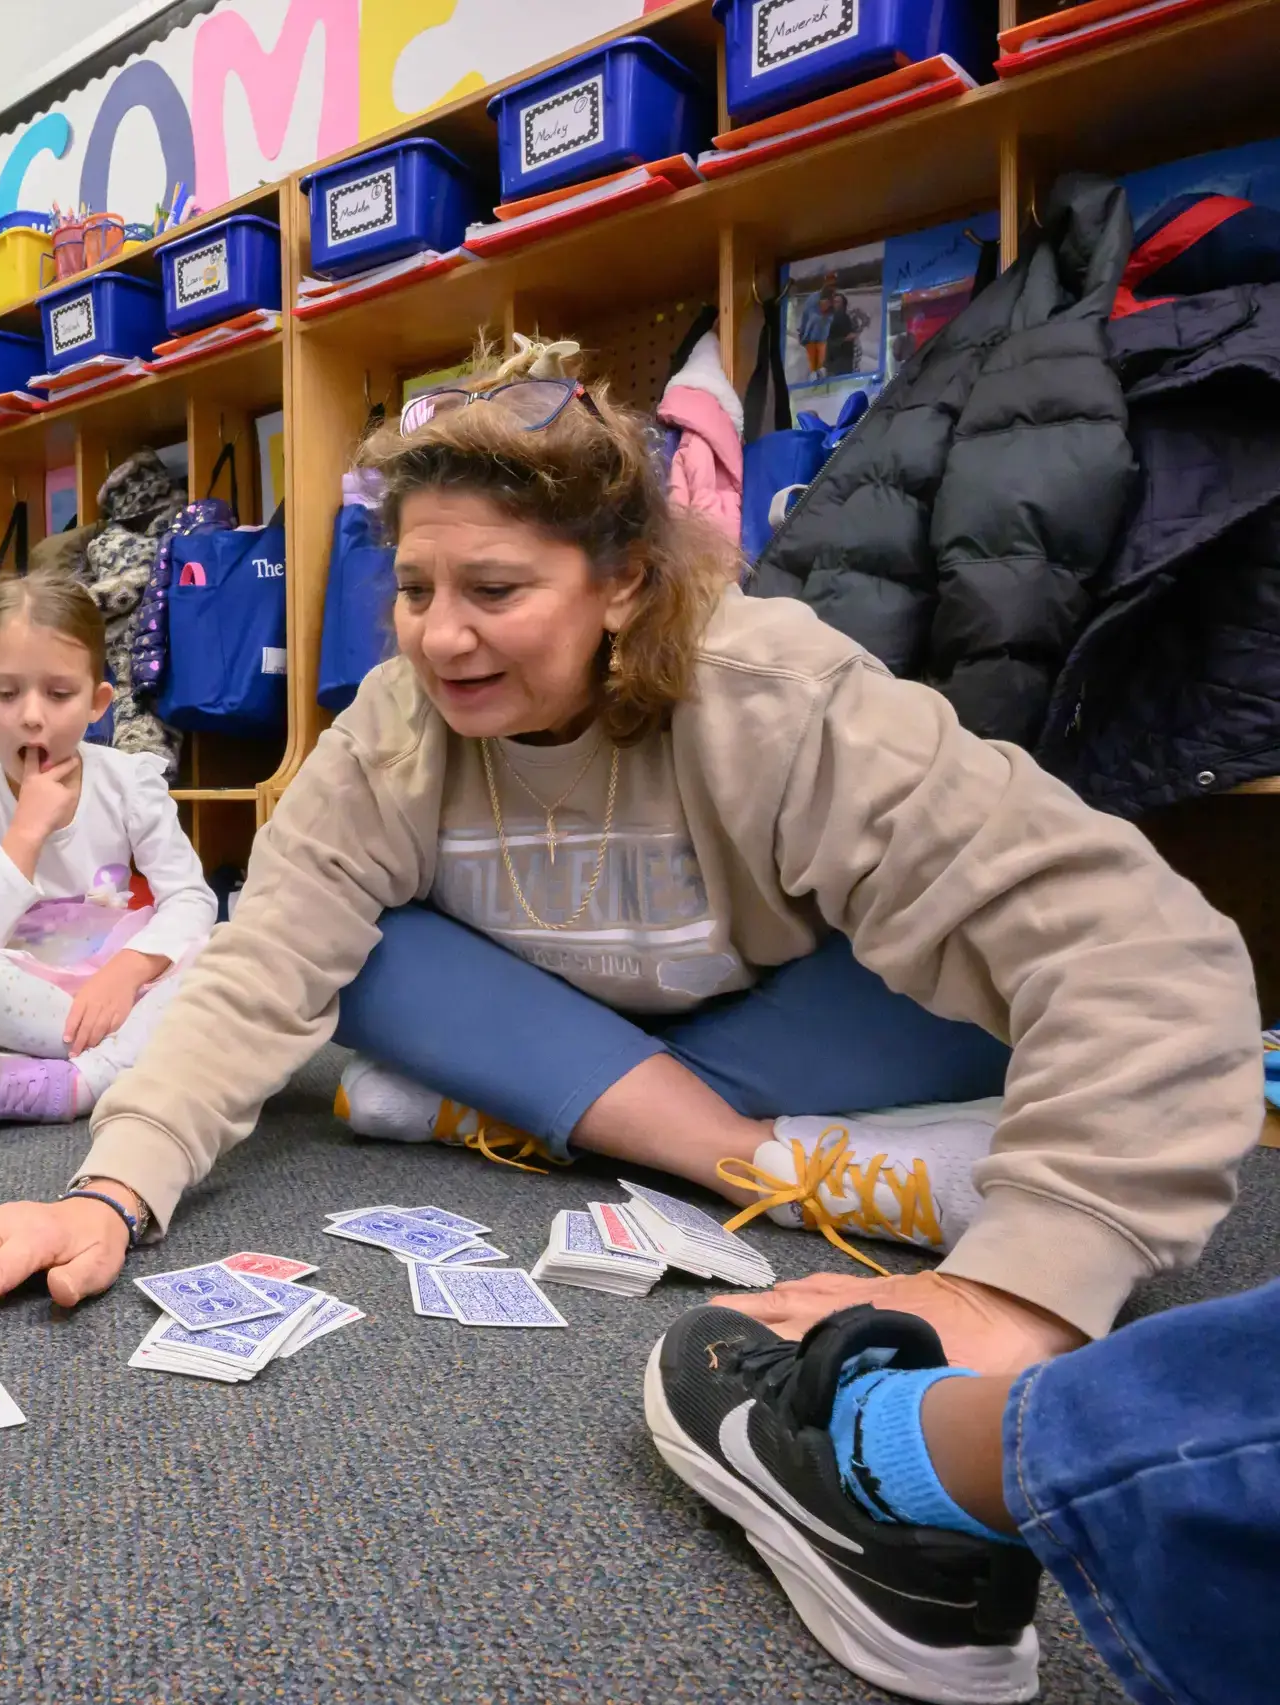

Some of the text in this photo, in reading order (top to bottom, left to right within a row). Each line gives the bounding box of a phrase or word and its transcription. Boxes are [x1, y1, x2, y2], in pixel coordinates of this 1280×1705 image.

[768, 3, 829, 45] Maverick
[251, 558, 284, 578] The
[440, 842, 711, 926] OLVERINES
